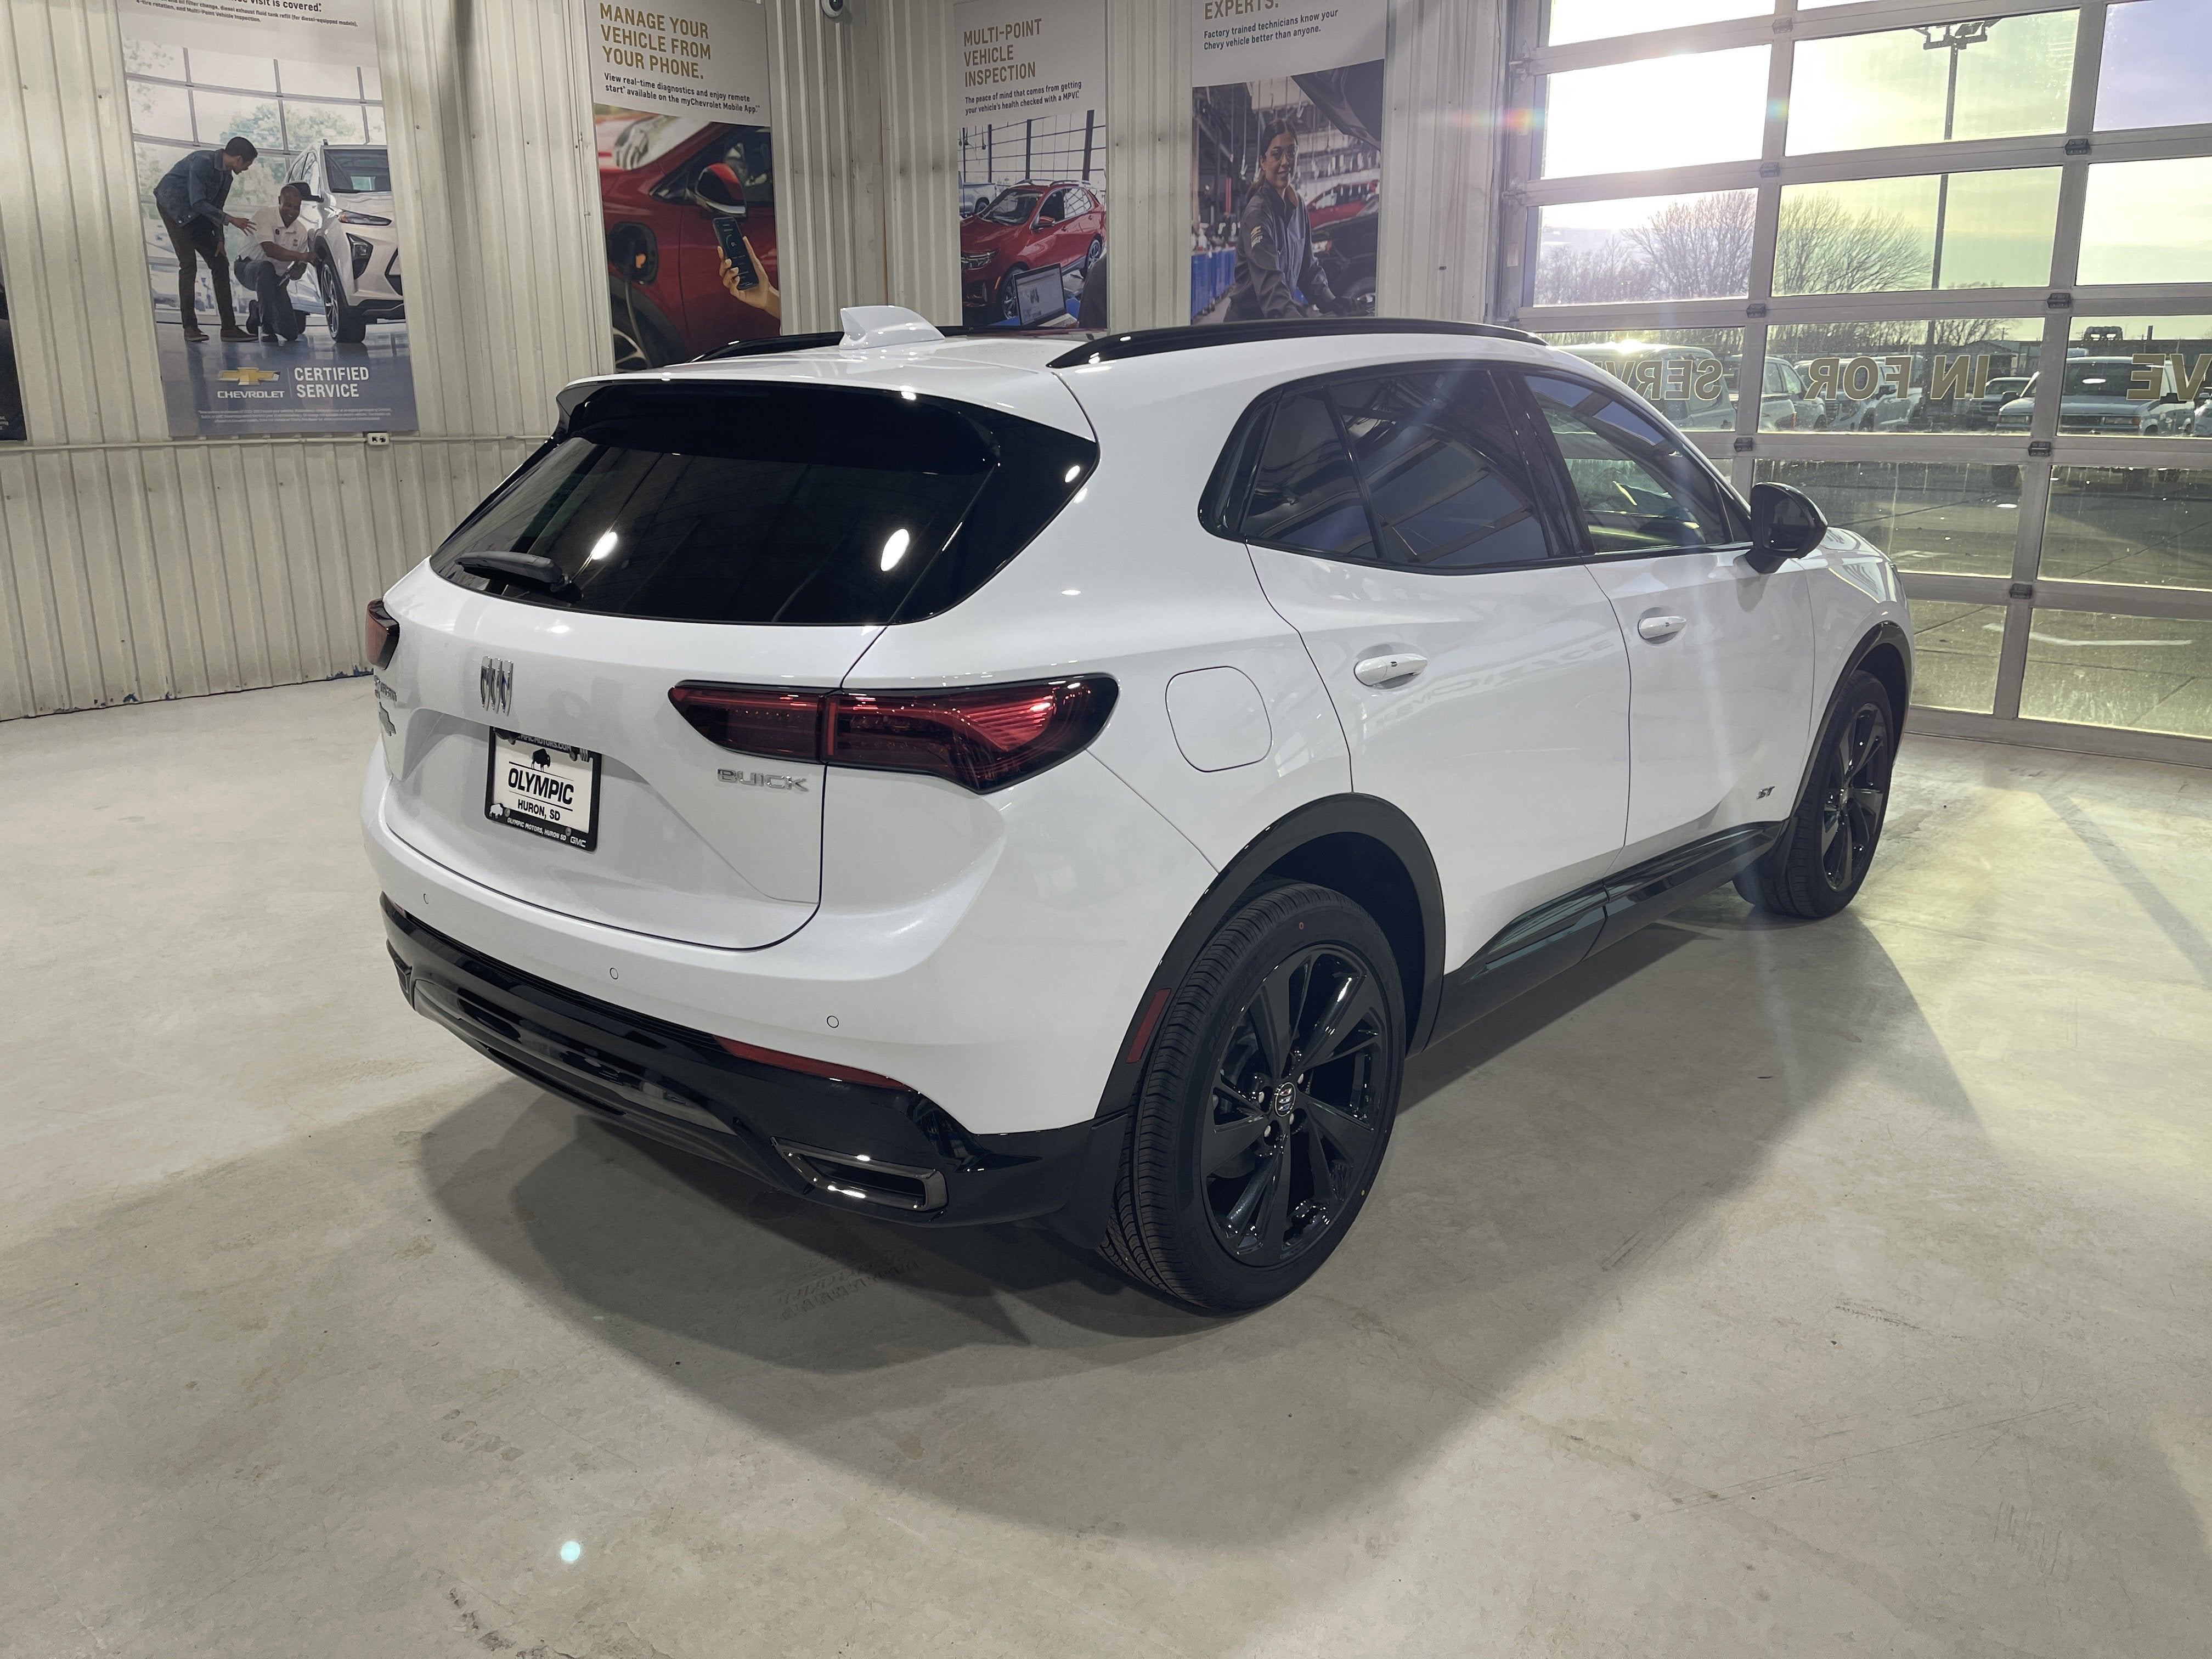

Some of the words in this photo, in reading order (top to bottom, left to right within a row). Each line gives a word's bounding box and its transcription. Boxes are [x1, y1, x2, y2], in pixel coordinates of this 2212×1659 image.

[153, 2, 176, 10] rotation,
[187, 7, 215, 16] Multi-Point
[599, 2, 666, 32] MANAGE
[669, 16, 709, 39] YOUR
[963, 18, 1042, 47] MULTI-POINT
[1204, 29, 1230, 39] Factory
[1232, 25, 1256, 36] trained
[1258, 18, 1299, 30] technicians
[1300, 14, 1319, 23] know
[1321, 10, 1339, 21] your
[600, 24, 667, 53] VEHICLE
[671, 38, 712, 60] FROM
[1204, 40, 1224, 50] Chevy
[1226, 37, 1250, 48] vehicle
[1251, 33, 1273, 43] better
[1276, 31, 1291, 40] than
[1293, 26, 1321, 38] anyone.
[602, 46, 645, 70] YOUR
[650, 54, 704, 80] PHONE.
[963, 44, 1014, 67] VEHICLE
[964, 61, 1036, 88] INSPECTION
[603, 72, 622, 83] View
[623, 76, 656, 89] real-time
[657, 82, 695, 96] diagnostics
[696, 89, 708, 98] and
[709, 91, 726, 102] enjoy
[728, 92, 751, 103] remote
[965, 96, 974, 104] The
[975, 94, 991, 105] peace
[992, 92, 998, 100] of
[999, 90, 1012, 99] mind
[1014, 88, 1025, 97] that
[1046, 84, 1059, 93] from
[1060, 81, 1082, 92] getting
[627, 88, 657, 100] available
[668, 94, 680, 104] the
[681, 97, 722, 110] myChevrolet
[723, 102, 743, 112] Mobile
[965, 107, 978, 116] your
[978, 103, 1001, 112] vehicle's
[1002, 99, 1019, 109] health
[1020, 96, 1043, 107] checked
[1044, 94, 1057, 103] with
[294, 366, 369, 381] CERTIFIED
[296, 383, 359, 398] SERVICE
[507, 768, 574, 805] OLYMPIC
[717, 769, 809, 792] BUICK
[517, 799, 547, 820] HURON,
[549, 809, 561, 821] SD
[507, 817, 524, 828] OLYMPIC
[524, 822, 544, 835] MOTORS,
[544, 828, 560, 839] HURON
[570, 836, 586, 848] GMC
